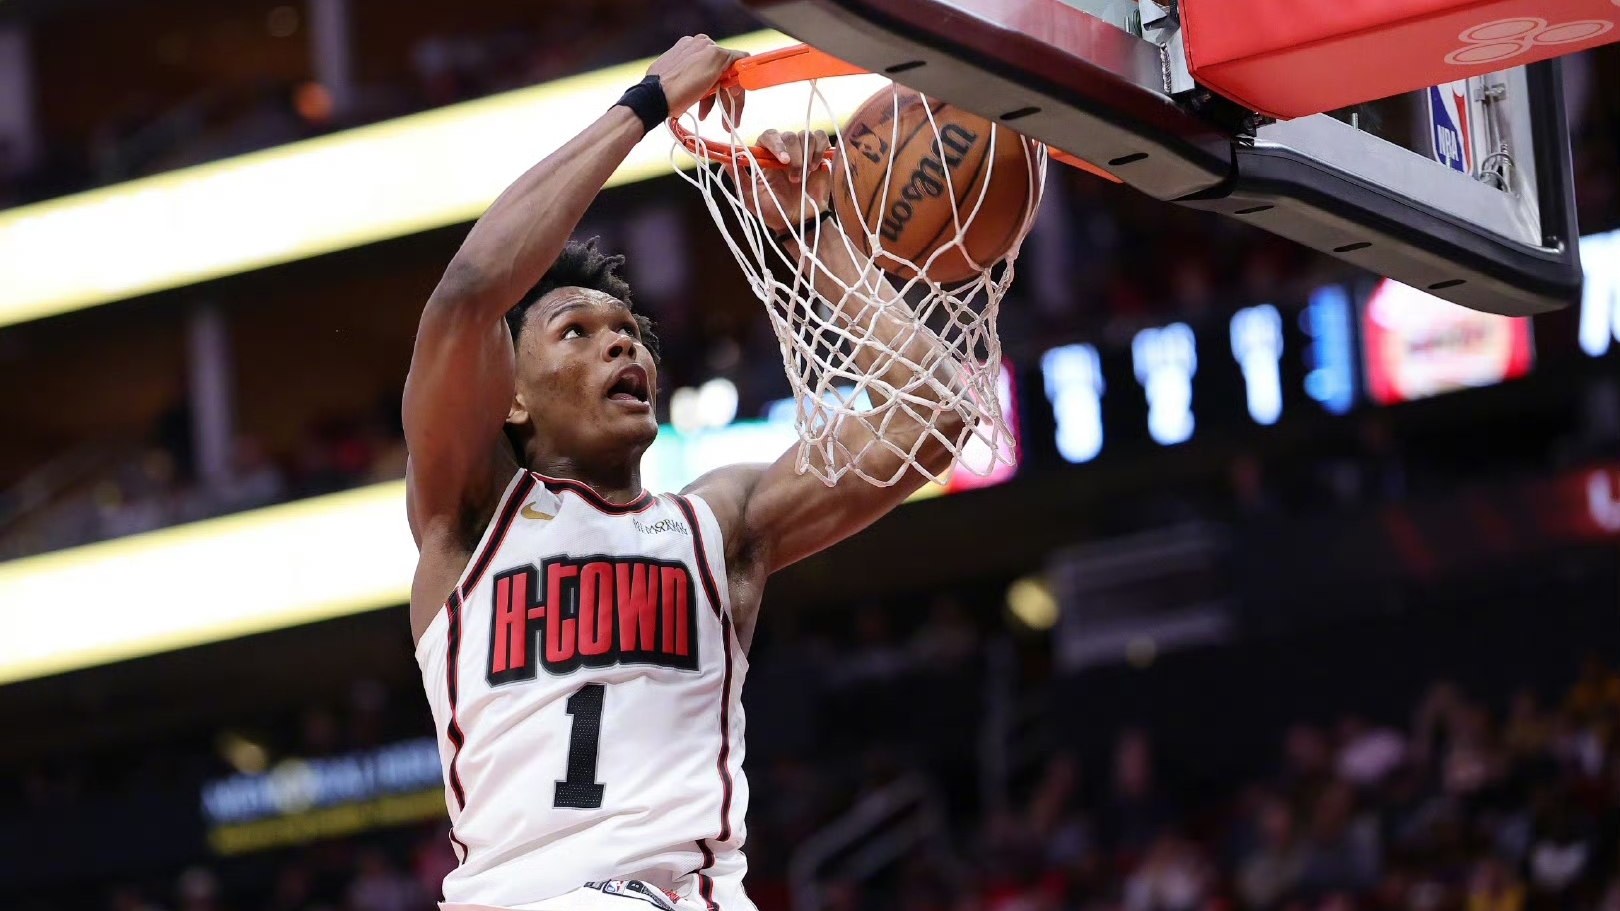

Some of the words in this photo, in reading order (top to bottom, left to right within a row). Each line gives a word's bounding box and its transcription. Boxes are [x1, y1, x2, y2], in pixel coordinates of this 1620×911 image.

[880, 122, 978, 243] Wilson
[1437, 124, 1460, 162] NBA
[553, 682, 606, 809] 1
